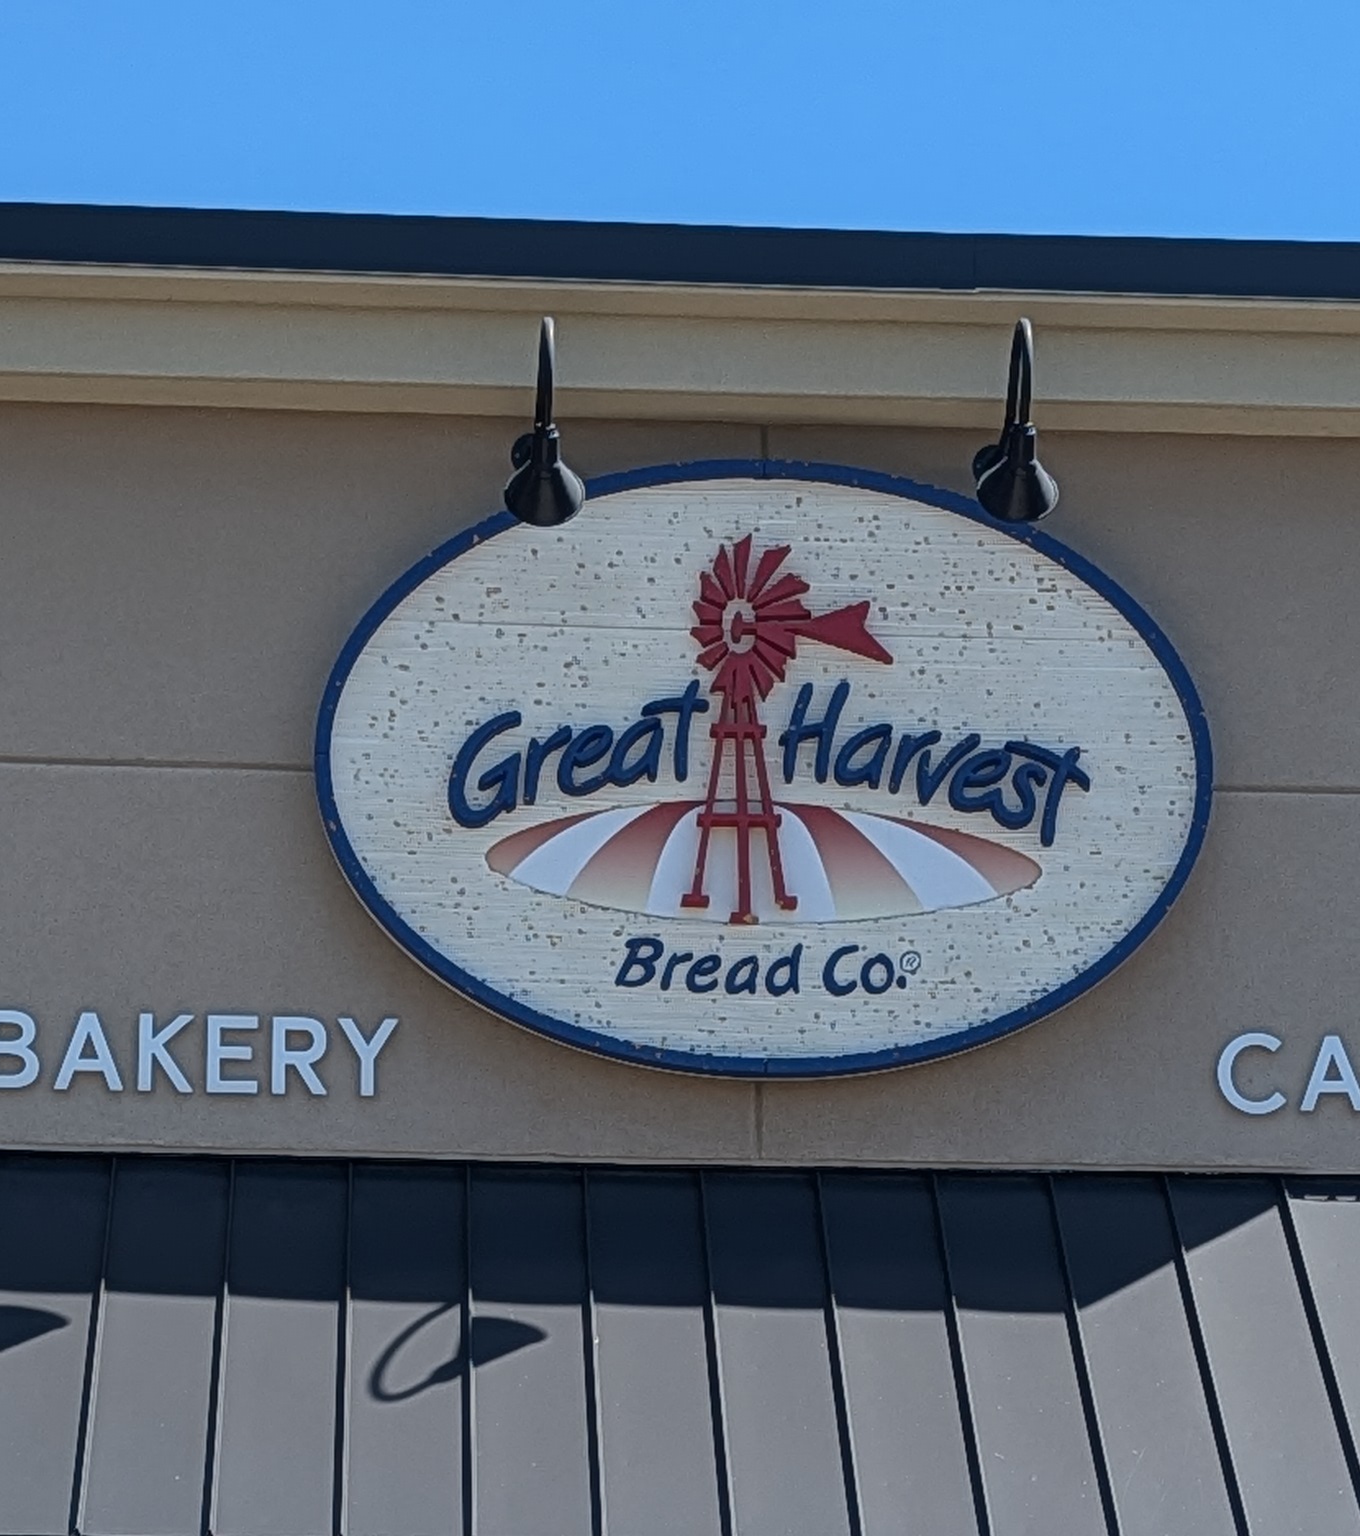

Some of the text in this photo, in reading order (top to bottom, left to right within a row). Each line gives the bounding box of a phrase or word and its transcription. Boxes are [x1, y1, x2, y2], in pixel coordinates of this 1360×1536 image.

[448, 679, 1091, 847] Great Harvest
[615, 937, 804, 996] Bread
